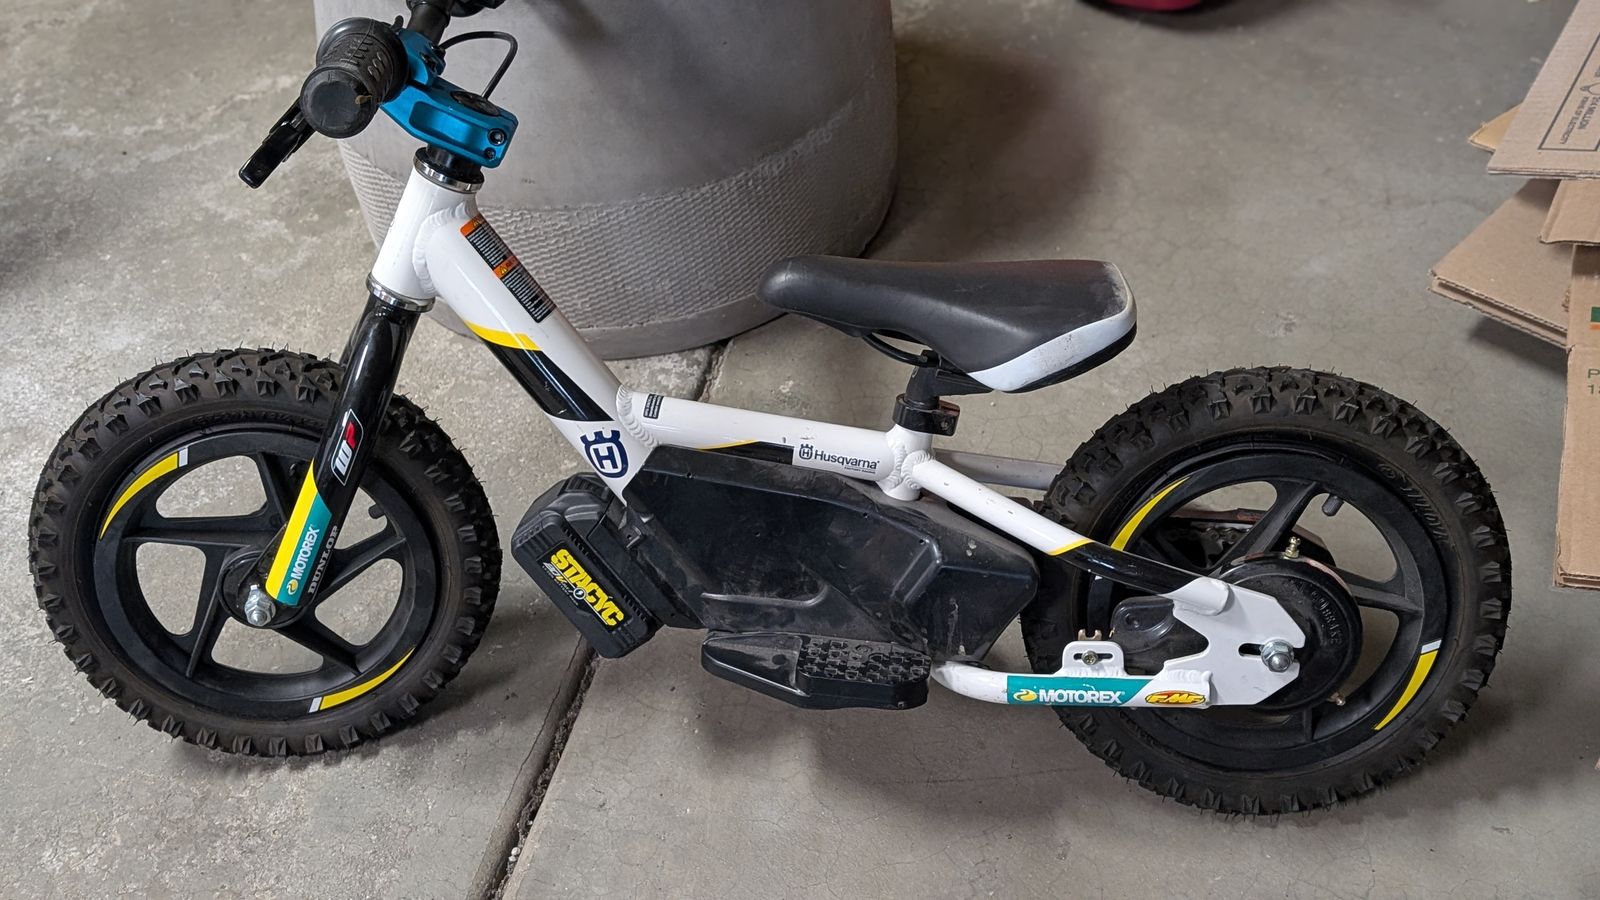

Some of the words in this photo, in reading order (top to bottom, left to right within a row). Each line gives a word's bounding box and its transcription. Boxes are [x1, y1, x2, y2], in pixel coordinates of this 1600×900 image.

[814, 449, 877, 470] Husqvarna
[290, 526, 320, 580] MOTOREX
[308, 525, 338, 594] DUNLOP
[551, 549, 625, 626] STACYC
[1039, 689, 1123, 704] MOTOREX
[1150, 693, 1206, 705] FMF
